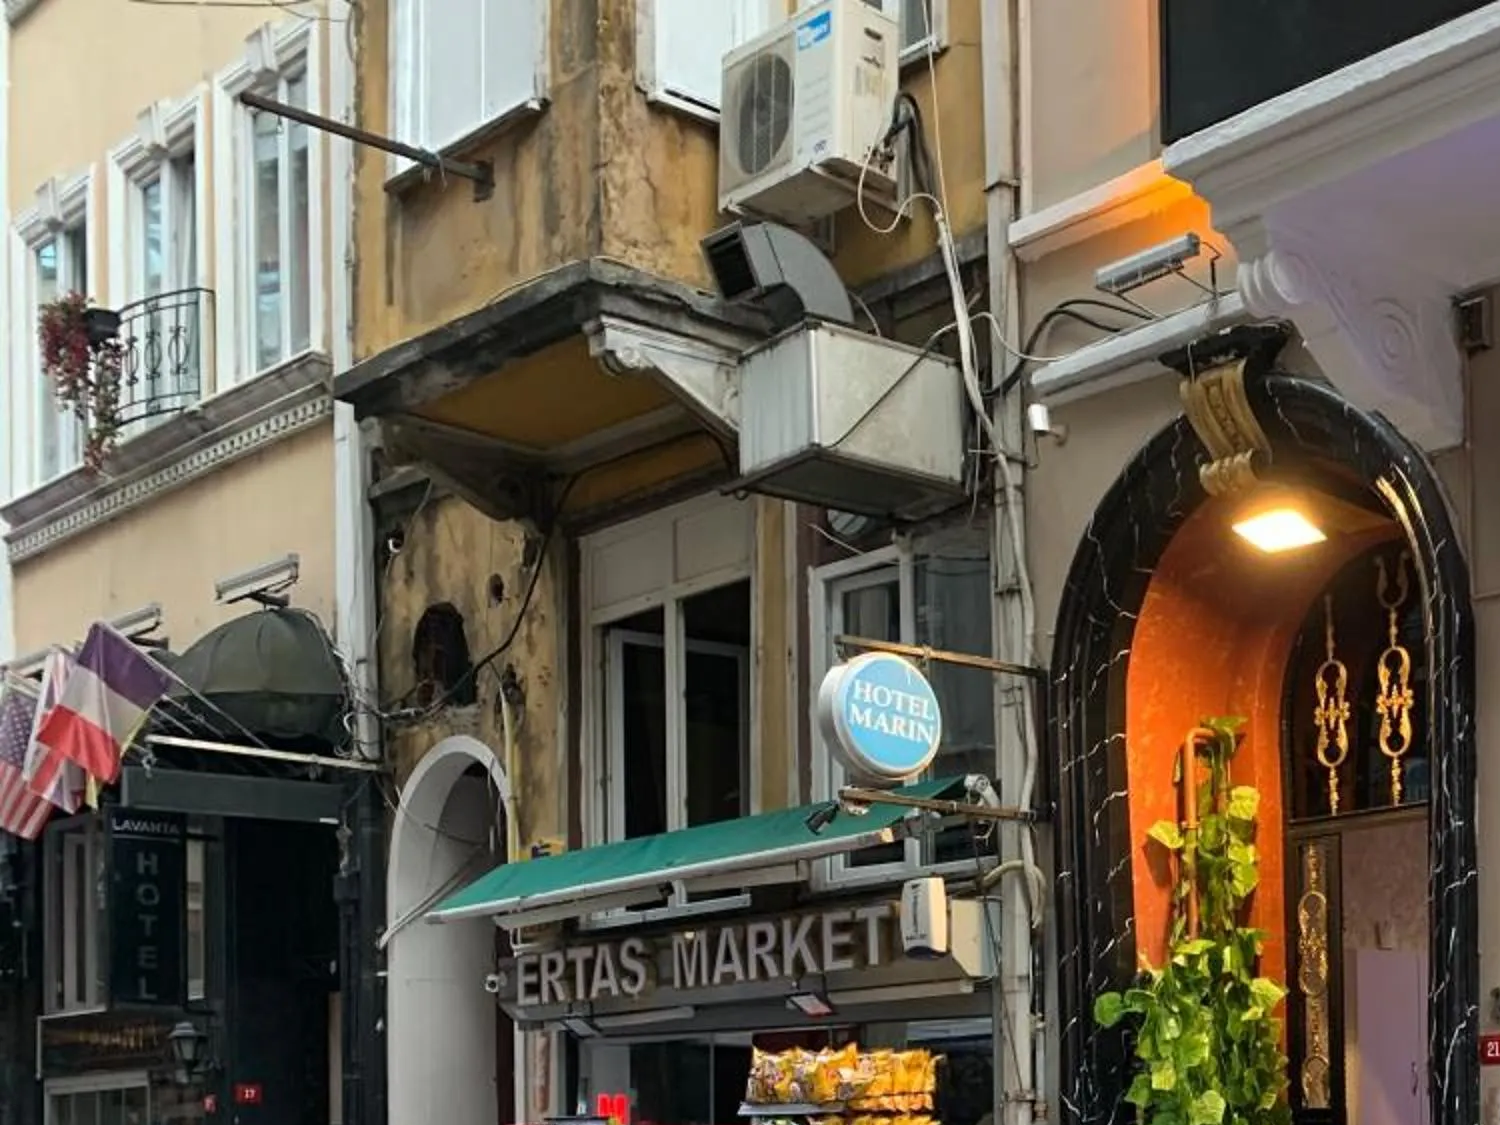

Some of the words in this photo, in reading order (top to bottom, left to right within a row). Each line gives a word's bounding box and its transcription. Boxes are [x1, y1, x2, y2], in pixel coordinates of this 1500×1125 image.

[853, 679, 935, 720] HOTEL
[849, 702, 935, 748] MARIN
[136, 851, 160, 1000] HOTEL
[672, 905, 891, 989] MARKET
[1486, 1040, 1500, 1058] 21
